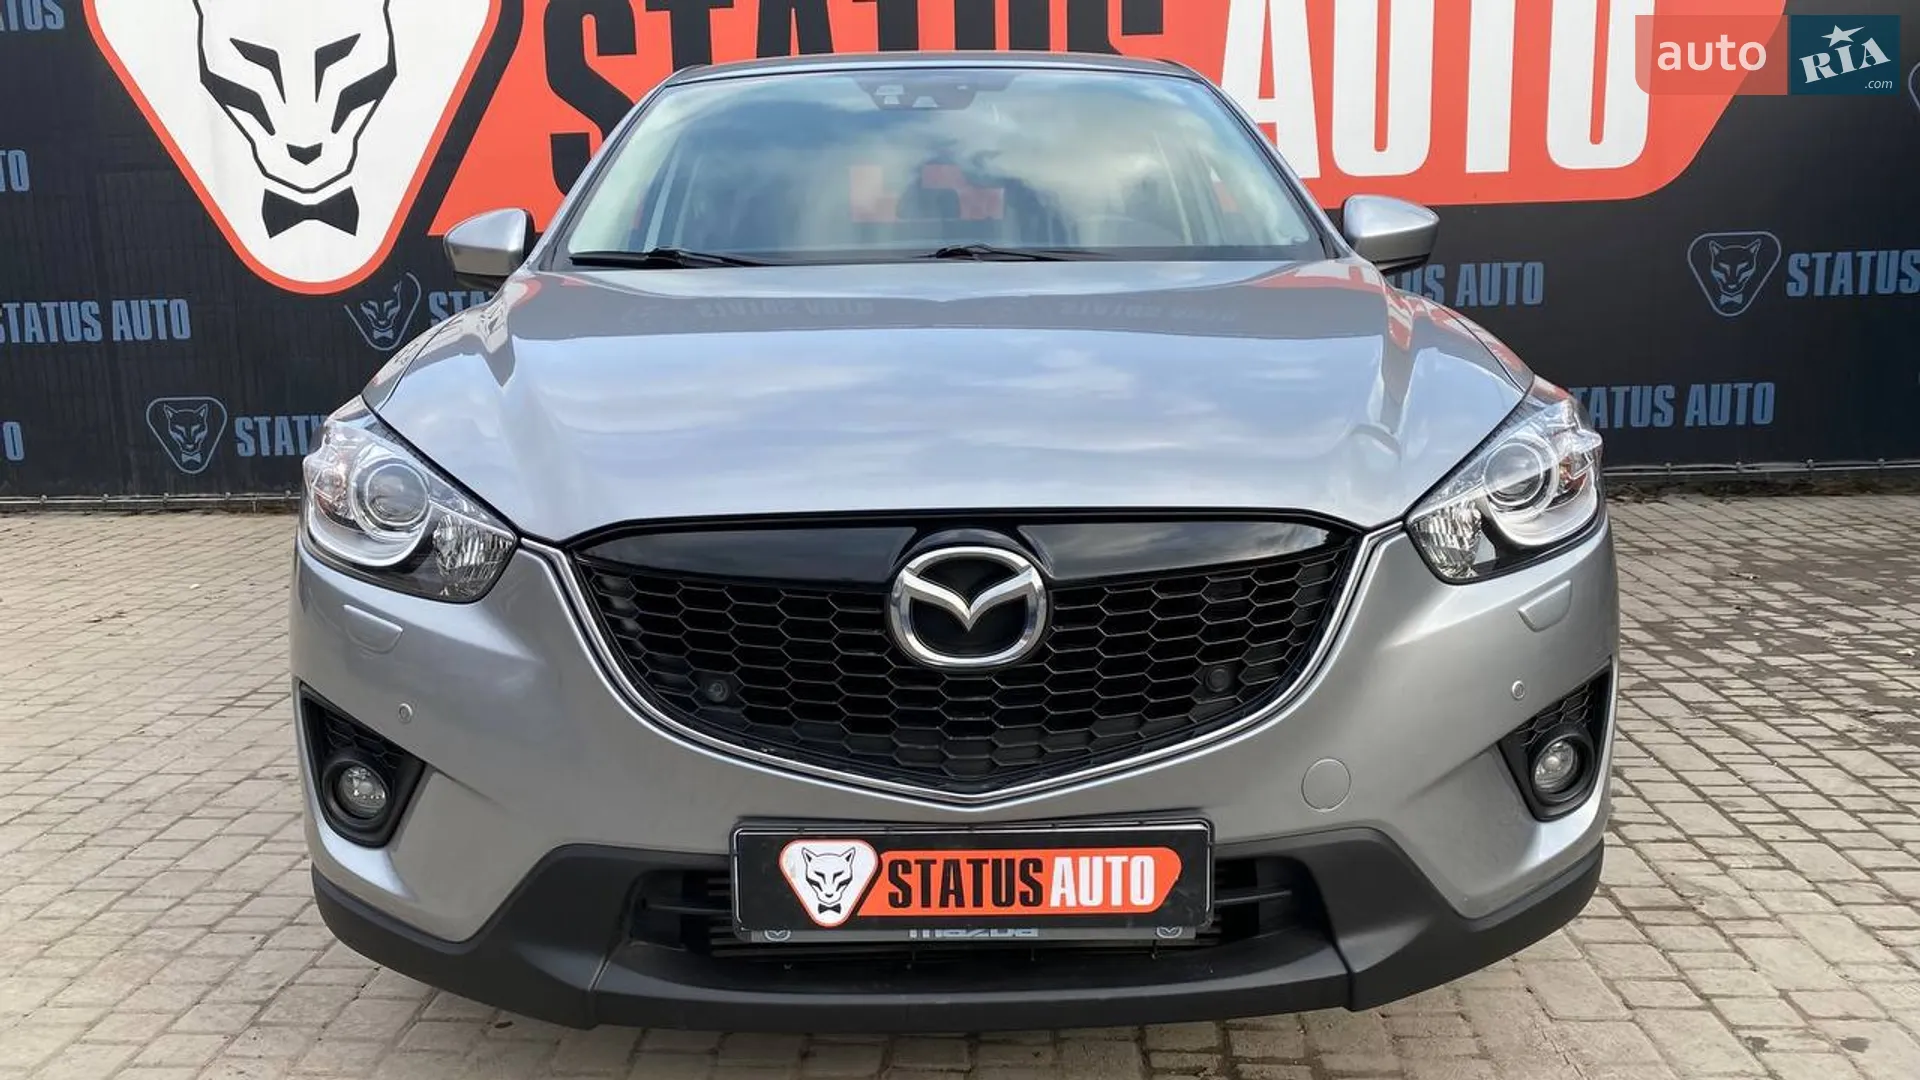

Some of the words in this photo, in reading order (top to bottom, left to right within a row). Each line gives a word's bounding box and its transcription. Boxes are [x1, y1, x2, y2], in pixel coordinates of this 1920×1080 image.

[1455, 261, 1544, 307] AUTO
[1786, 250, 1920, 297] STATUS
[0, 301, 102, 343] TATUS
[112, 299, 192, 341] AUTO
[1684, 381, 1776, 427] AUTO
[887, 857, 1044, 909] STATUS
[1049, 854, 1156, 908] AUTO
